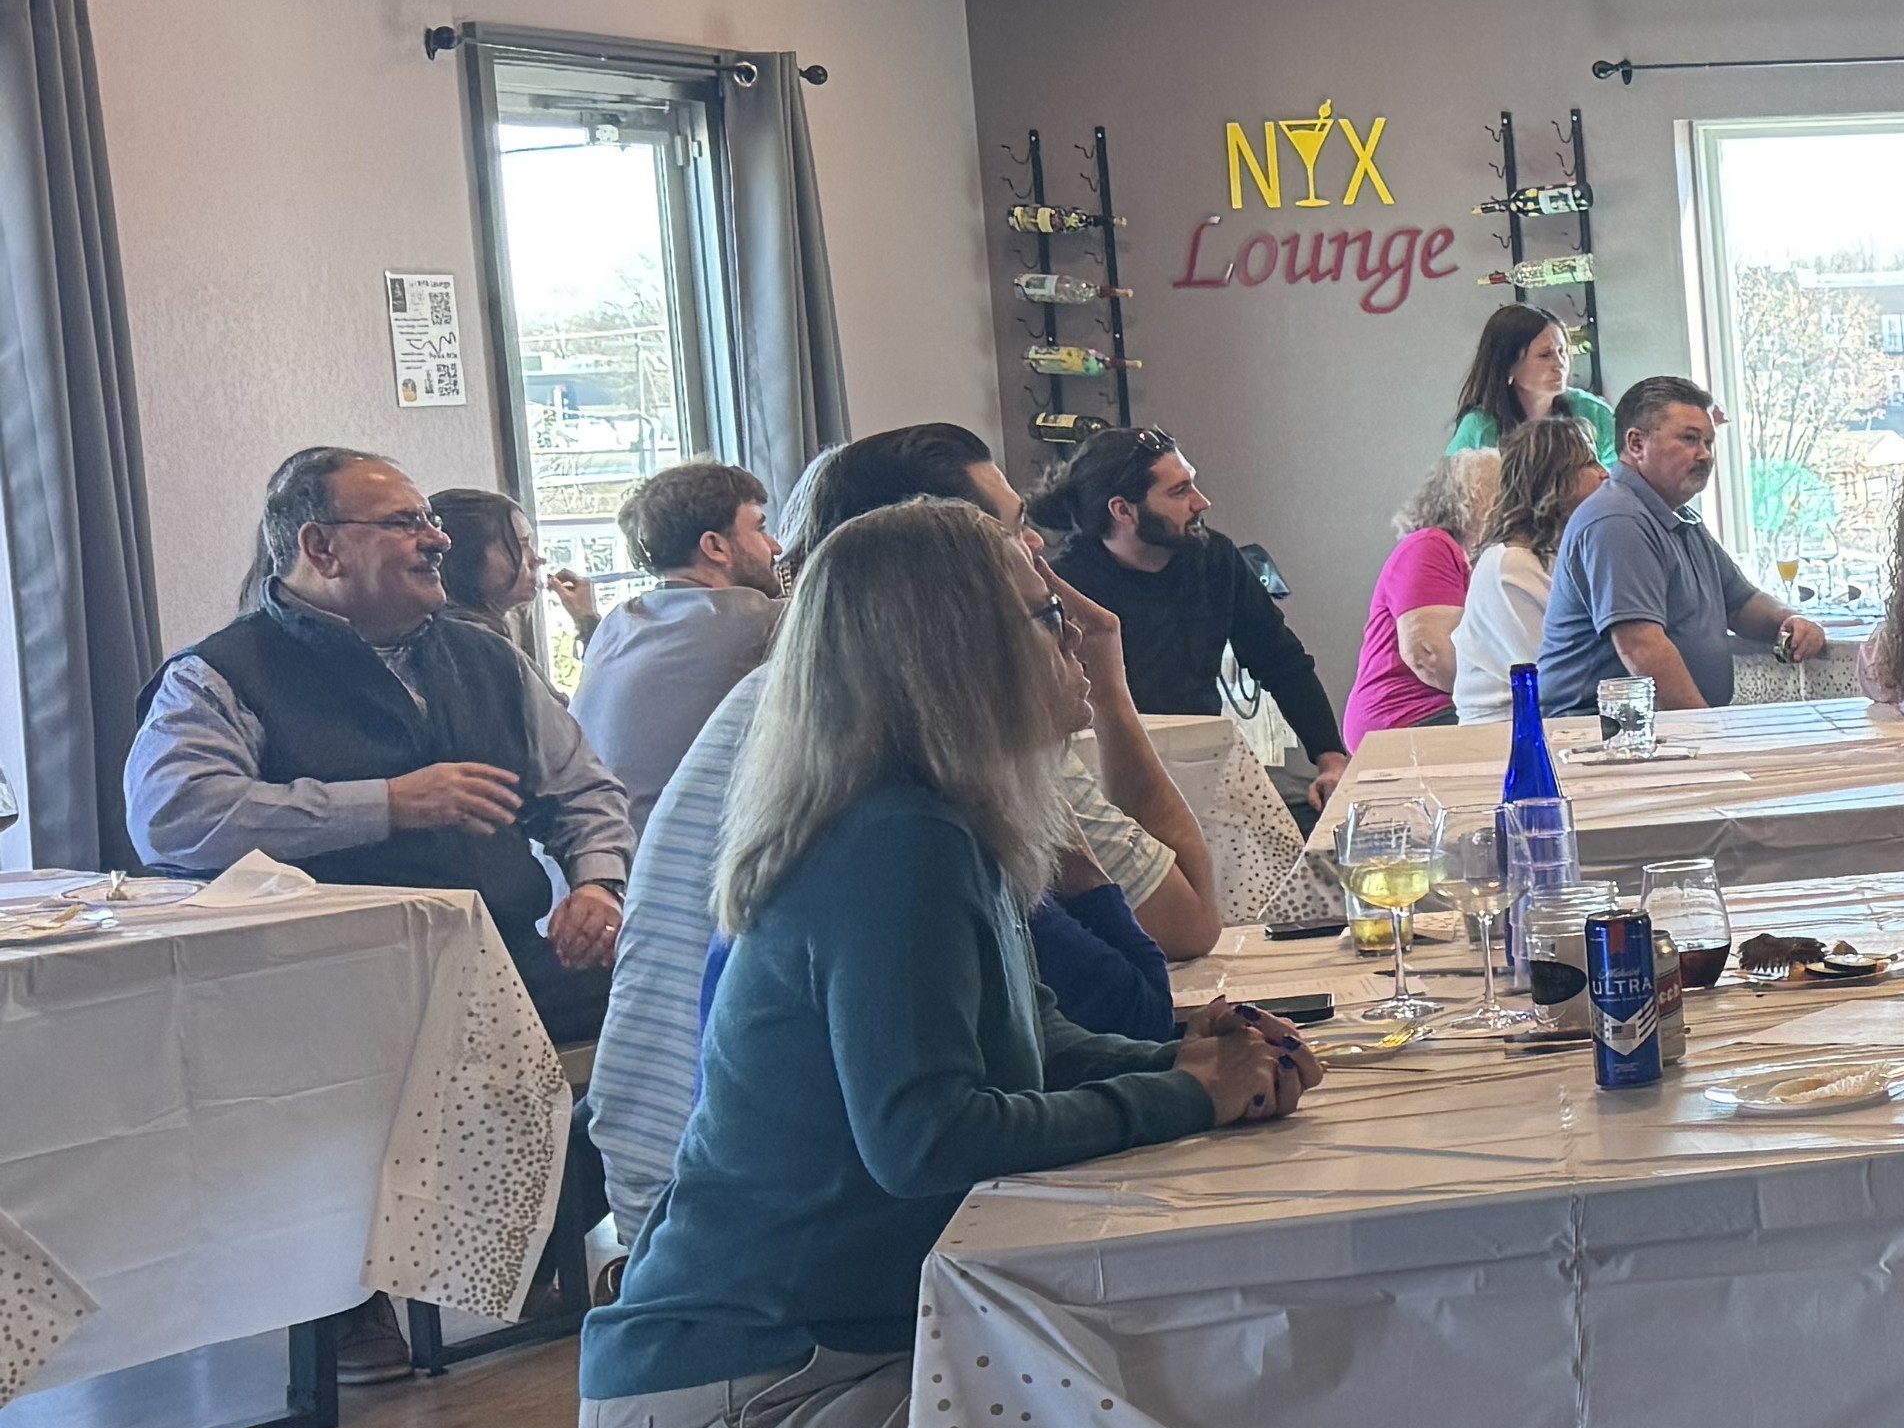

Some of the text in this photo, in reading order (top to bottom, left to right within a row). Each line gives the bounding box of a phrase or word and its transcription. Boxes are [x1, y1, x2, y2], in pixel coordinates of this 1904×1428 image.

[1226, 99, 1395, 209] NYX
[1172, 215, 1459, 314] Lounge
[1592, 976, 1653, 996] ULTRA
